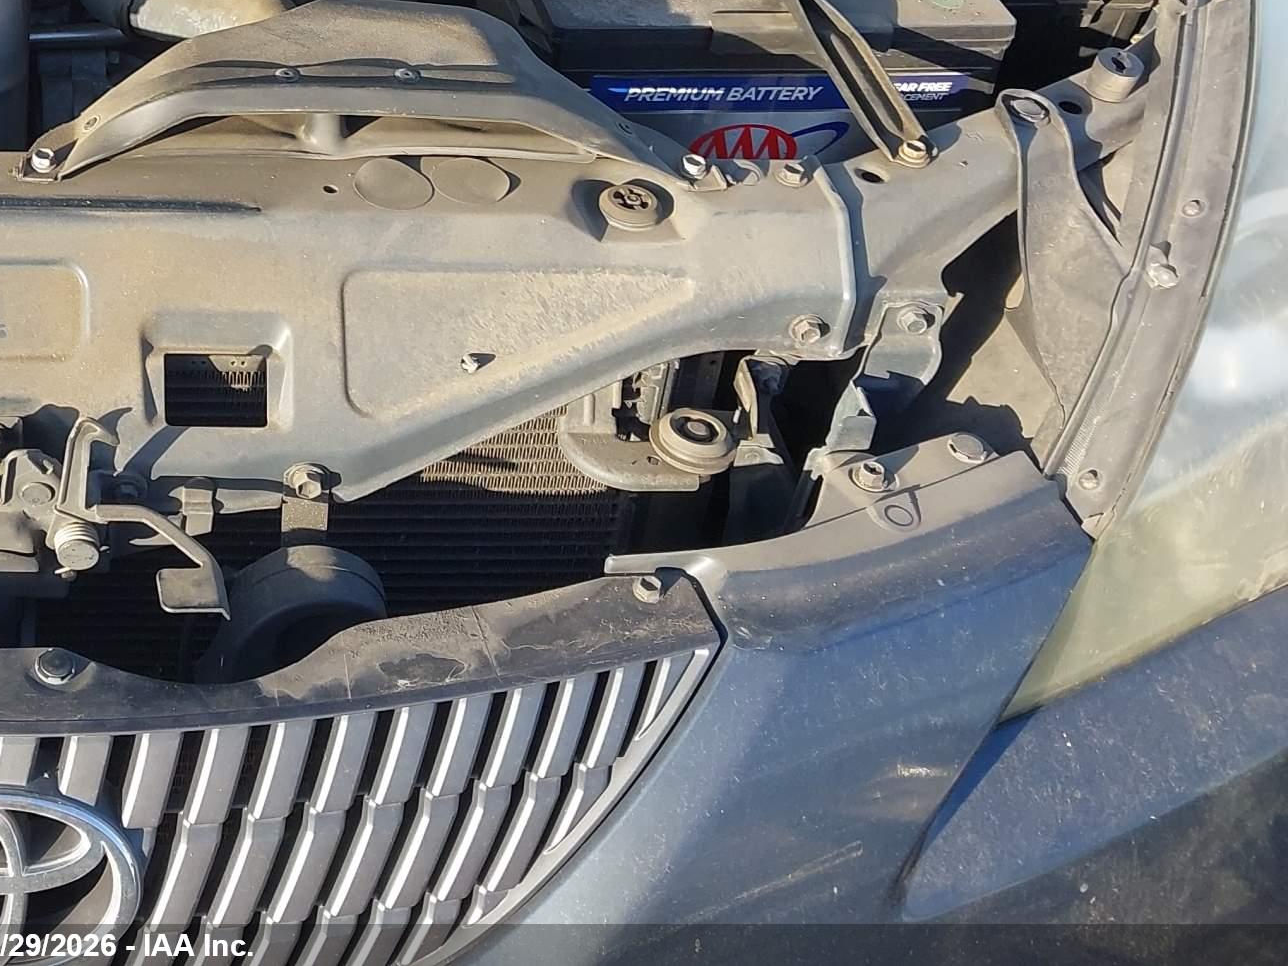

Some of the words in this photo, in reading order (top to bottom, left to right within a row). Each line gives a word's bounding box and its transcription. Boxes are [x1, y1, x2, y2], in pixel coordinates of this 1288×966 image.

[917, 81, 953, 92] FREE
[623, 86, 724, 102] PREMIUM
[726, 86, 824, 102] BATTERY
